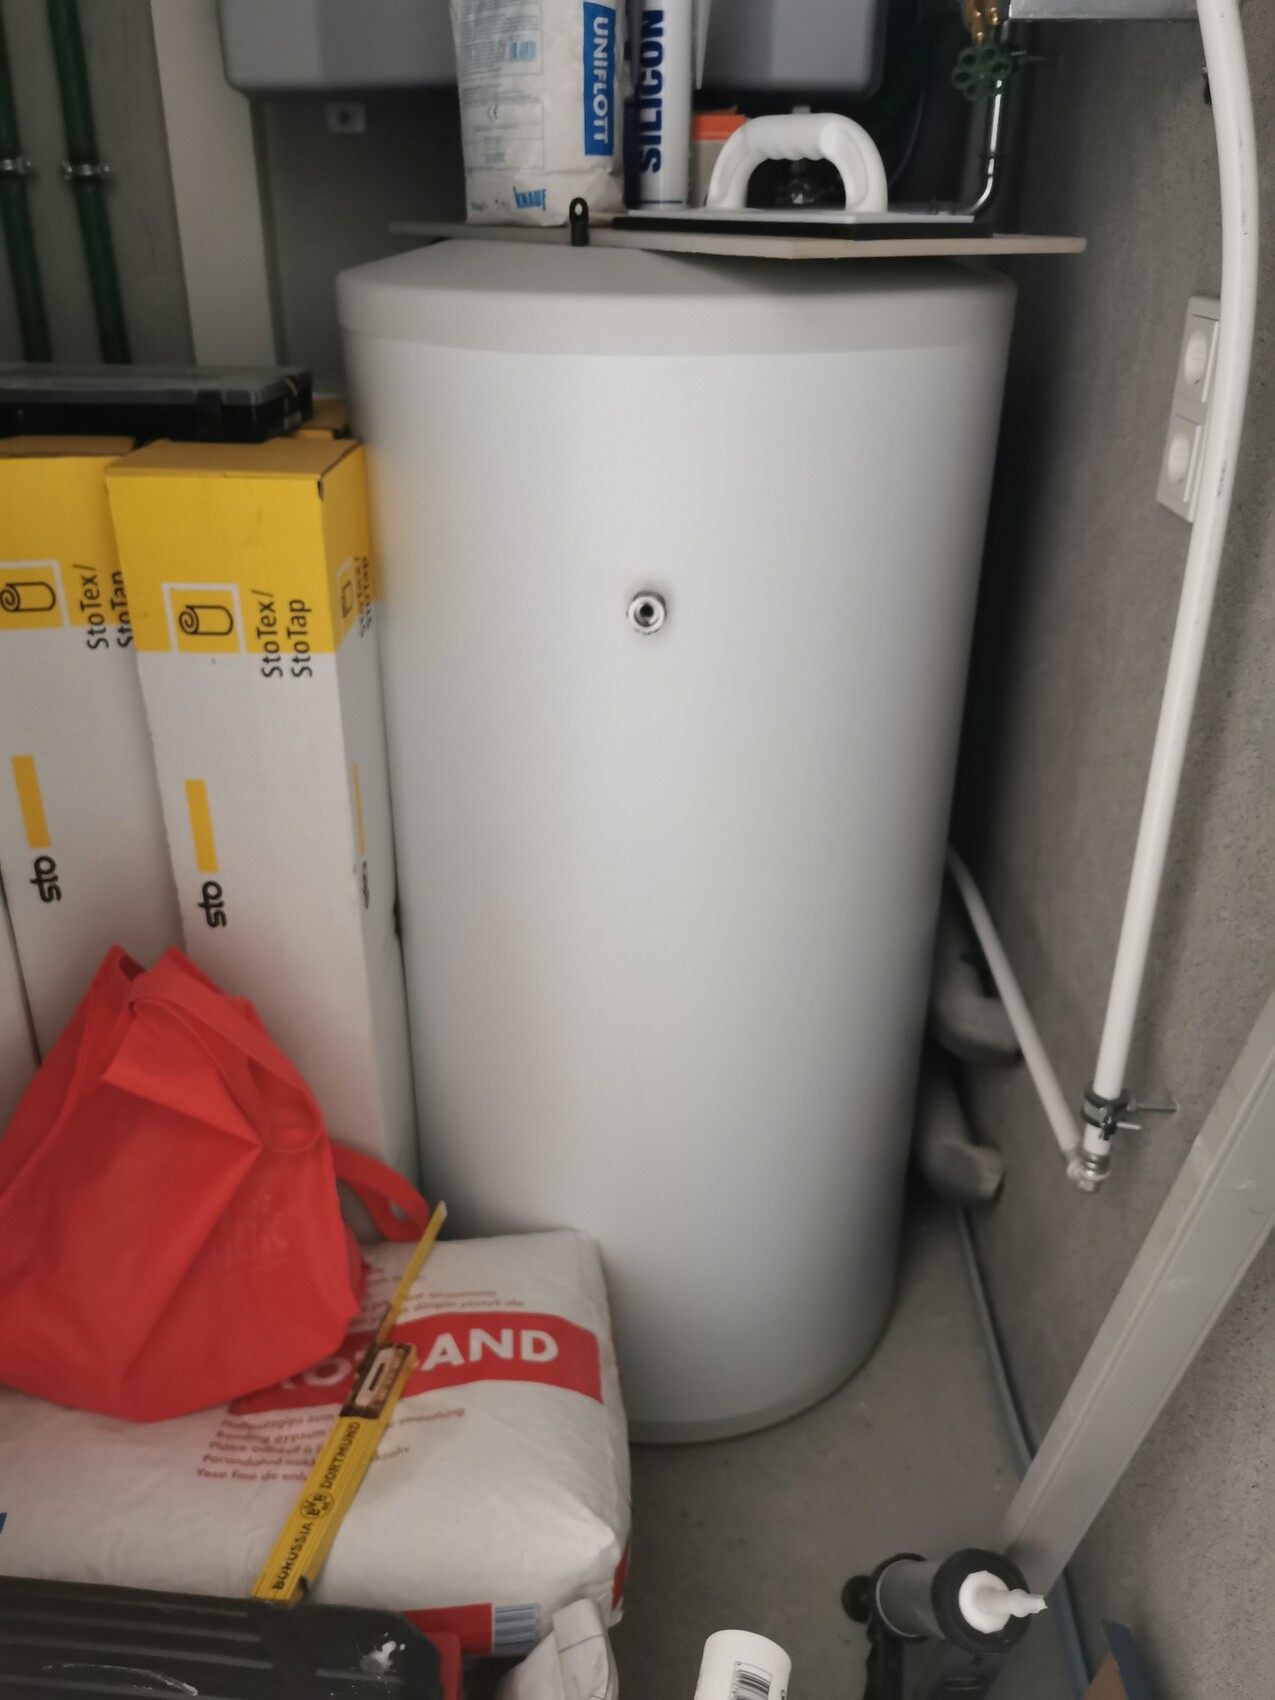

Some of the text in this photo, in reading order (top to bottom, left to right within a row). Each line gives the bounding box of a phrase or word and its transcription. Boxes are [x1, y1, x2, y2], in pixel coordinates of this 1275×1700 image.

[592, 16, 609, 144] UNIFLOTT
[639, 9, 664, 174] SILICON
[513, 186, 547, 211] KNAUF
[72, 563, 109, 650] StoTex/
[251, 589, 284, 678] StoTex/
[287, 599, 313, 678] StoTap
[272, 1522, 313, 1591] BORUSSIA
[319, 1421, 361, 1490] DORTMUND
